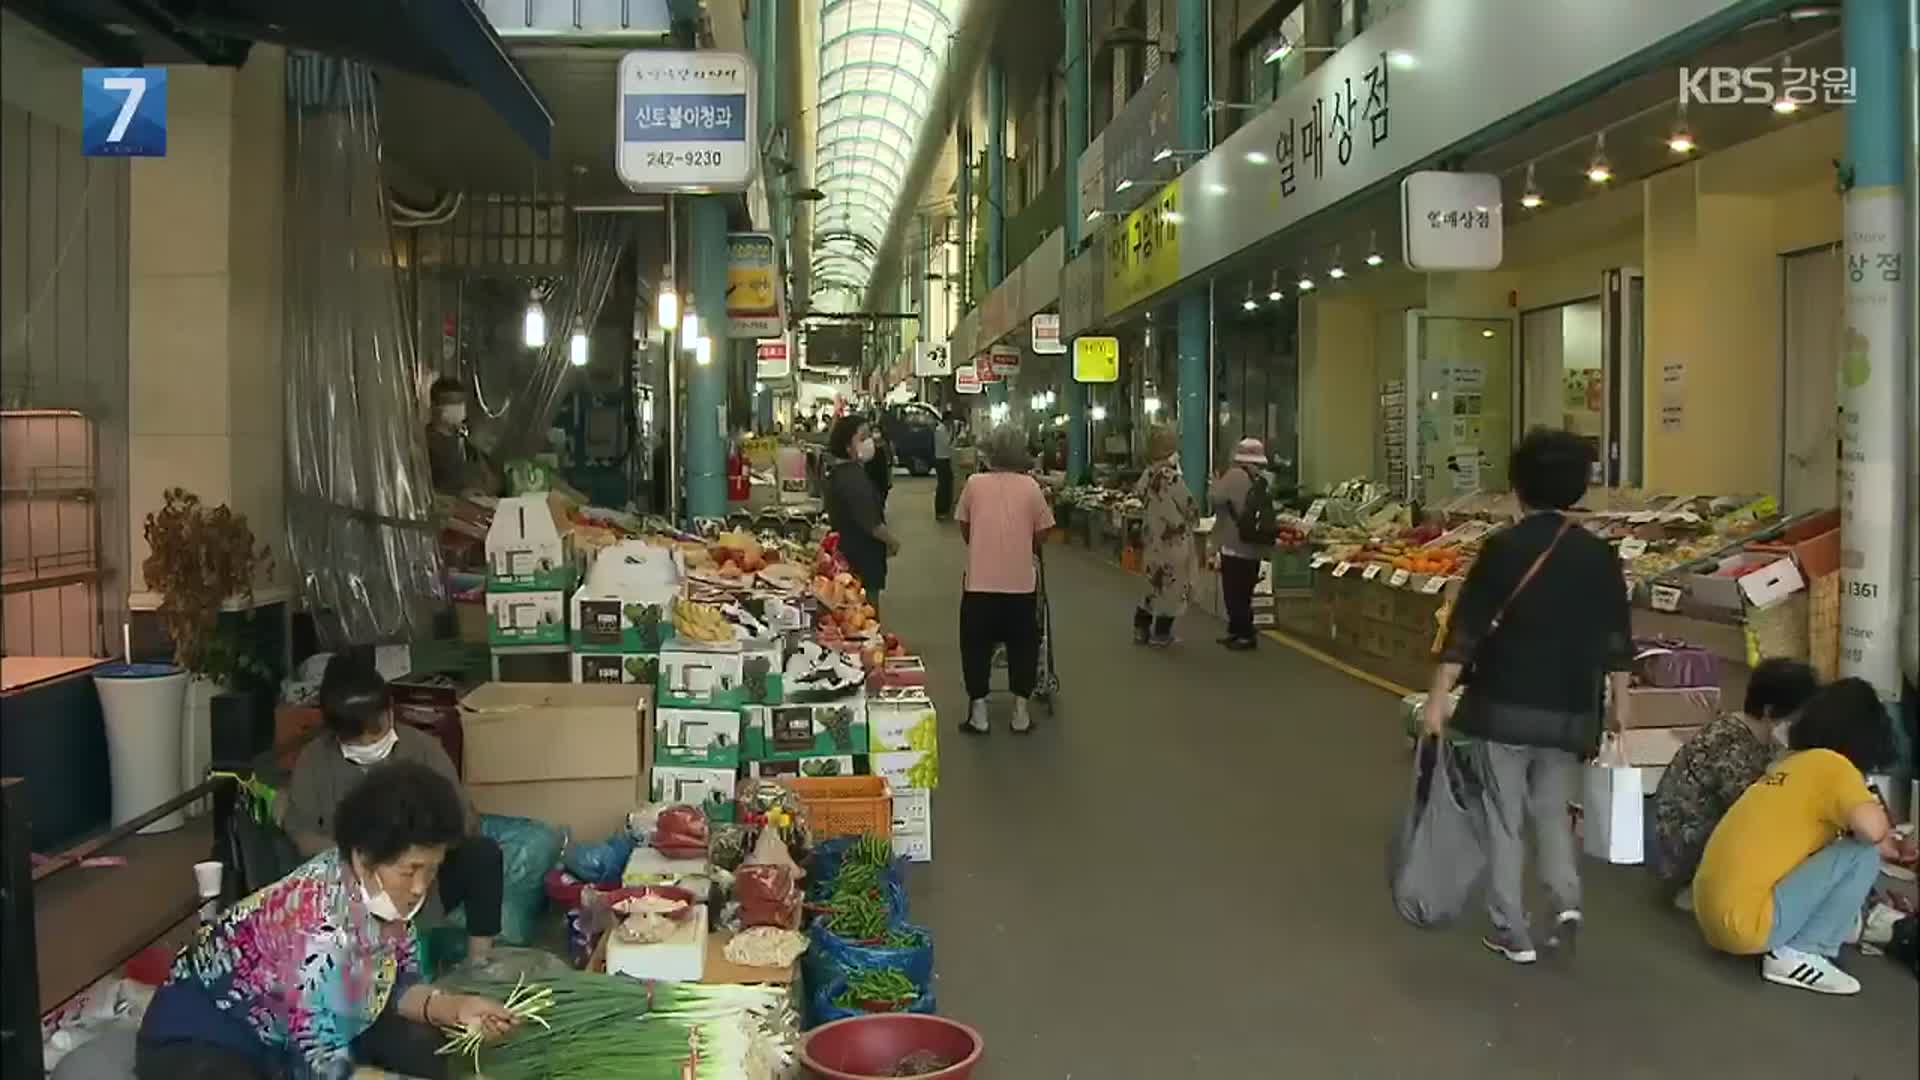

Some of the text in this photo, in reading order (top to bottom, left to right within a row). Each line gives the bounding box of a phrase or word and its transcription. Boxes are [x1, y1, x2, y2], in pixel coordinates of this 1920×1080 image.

[1276, 51, 1389, 197] 열매상점
[647, 151, 722, 167] 242-9230
[1427, 210, 1489, 229] 열매상점
